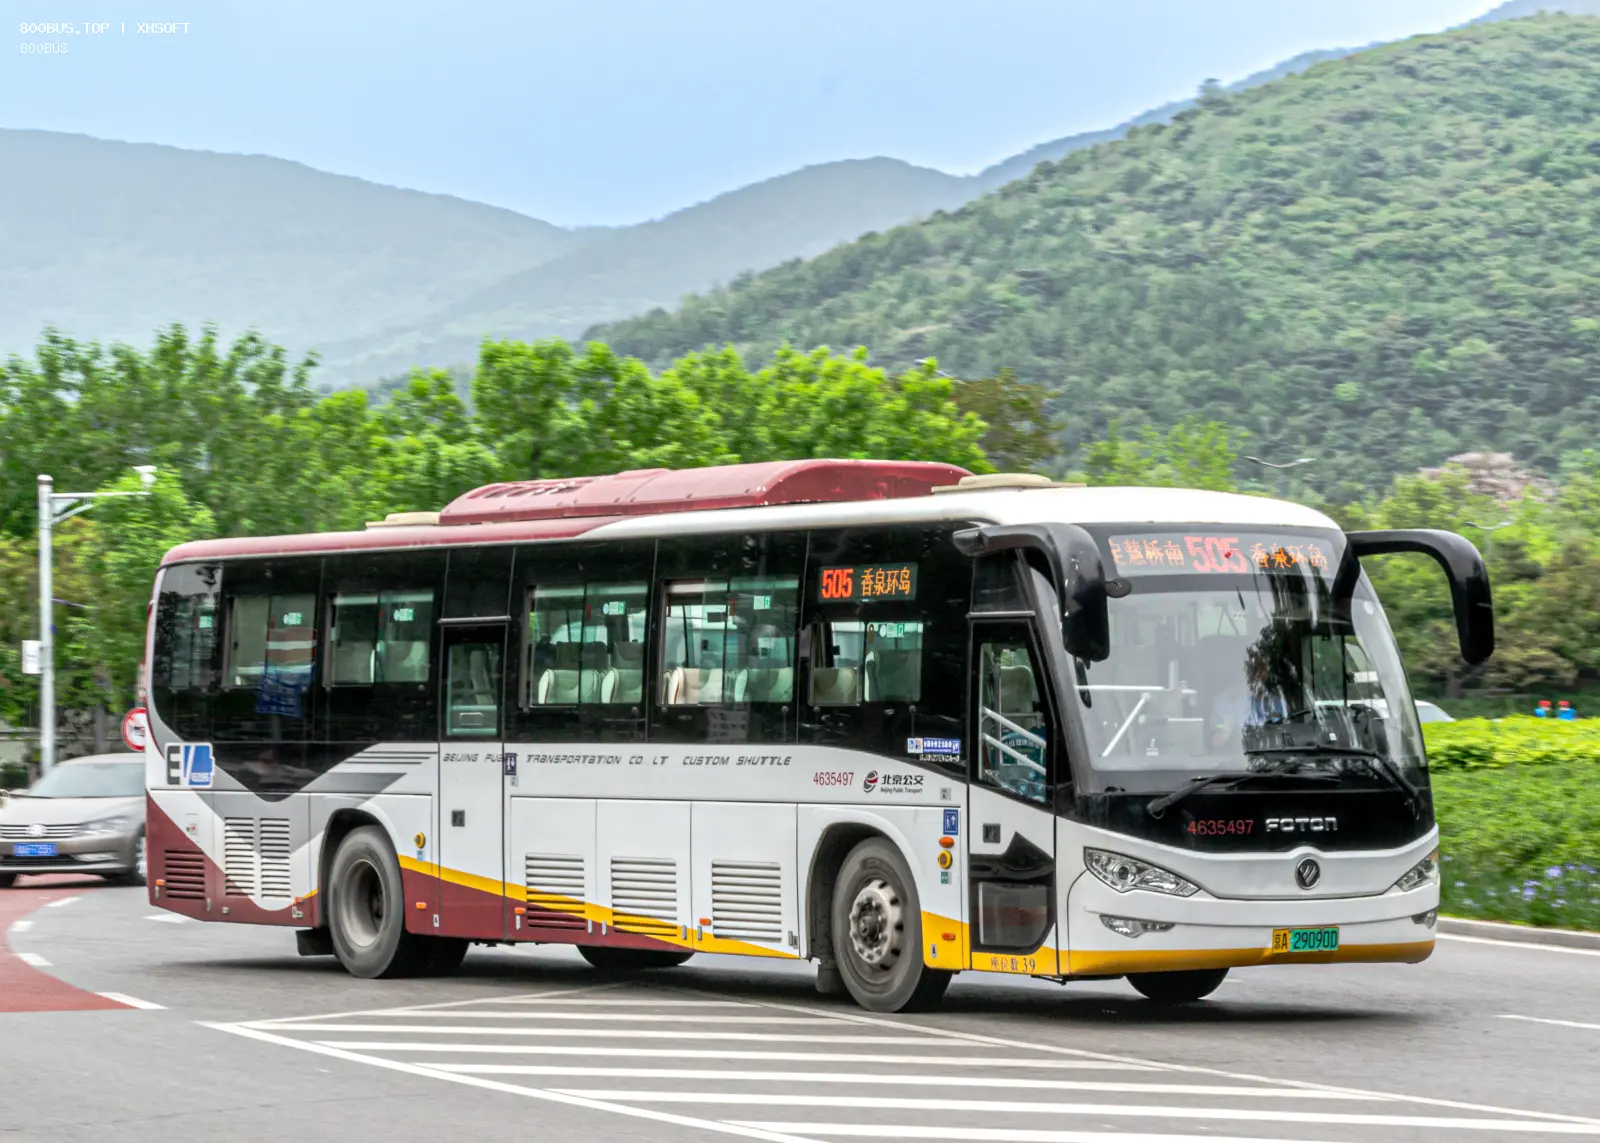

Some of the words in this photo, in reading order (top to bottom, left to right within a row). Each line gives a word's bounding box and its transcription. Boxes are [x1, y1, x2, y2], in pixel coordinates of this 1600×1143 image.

[1183, 536, 1247, 573] 505
[821, 568, 854, 598] 505
[860, 566, 911, 596] 香泉环岛
[443, 753, 479, 762] BEIJING
[526, 754, 621, 765] TRANSPORTATION
[682, 756, 730, 766] CUSTOM
[736, 756, 792, 766] SHUTTLE
[813, 772, 854, 786] 4635497
[881, 774, 925, 786] 北京公交
[1187, 819, 1254, 835] 4635497
[1265, 817, 1338, 832] FOTON
[1022, 957, 1036, 973] 39
